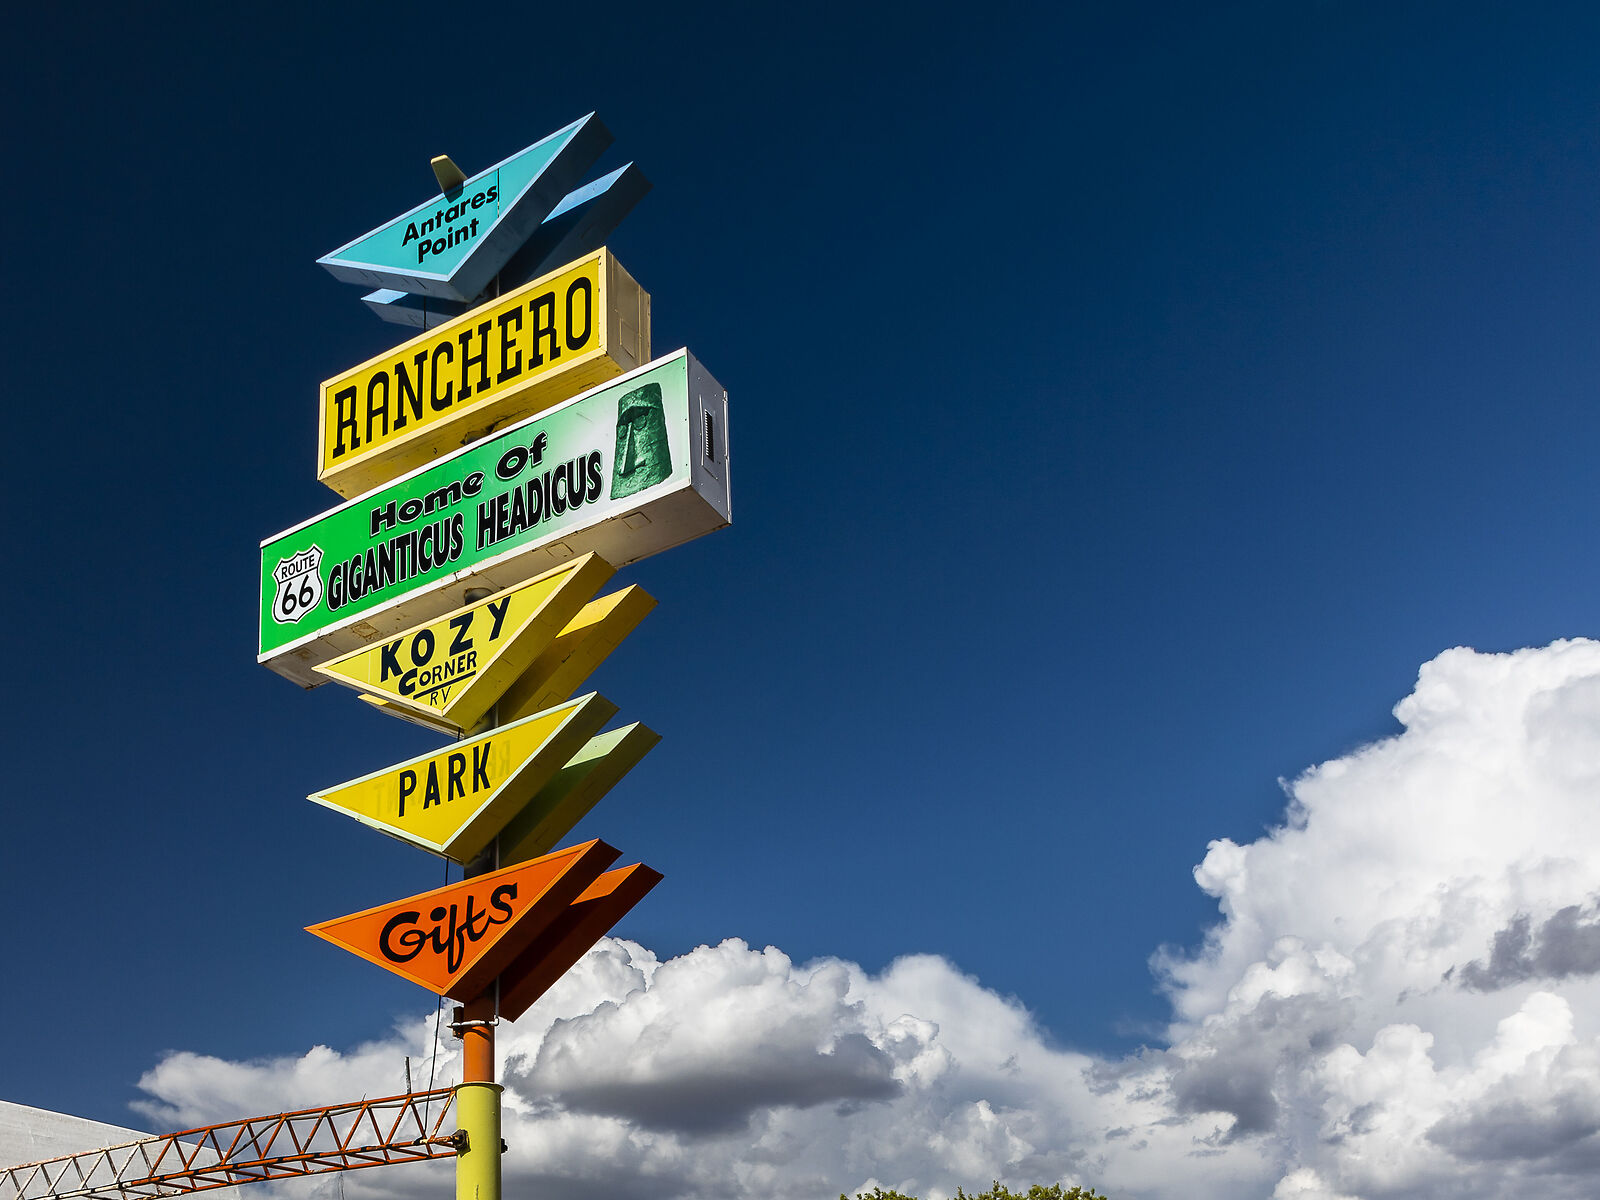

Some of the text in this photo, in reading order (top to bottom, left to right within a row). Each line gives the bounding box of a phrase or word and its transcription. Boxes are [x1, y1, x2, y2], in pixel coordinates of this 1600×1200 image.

[401, 183, 498, 246] Antares
[418, 218, 480, 264] Point
[332, 276, 593, 459] RANCHERO
[370, 431, 548, 537] Home Of
[327, 450, 603, 612] GIGANTICUS HEADICUS
[281, 554, 315, 580] ROUTE
[281, 574, 315, 615] 66
[380, 595, 511, 683] KOZY
[398, 650, 477, 696] CORNER
[429, 686, 451, 706] RV
[398, 741, 491, 817] PARK
[379, 882, 518, 974] Gifts
